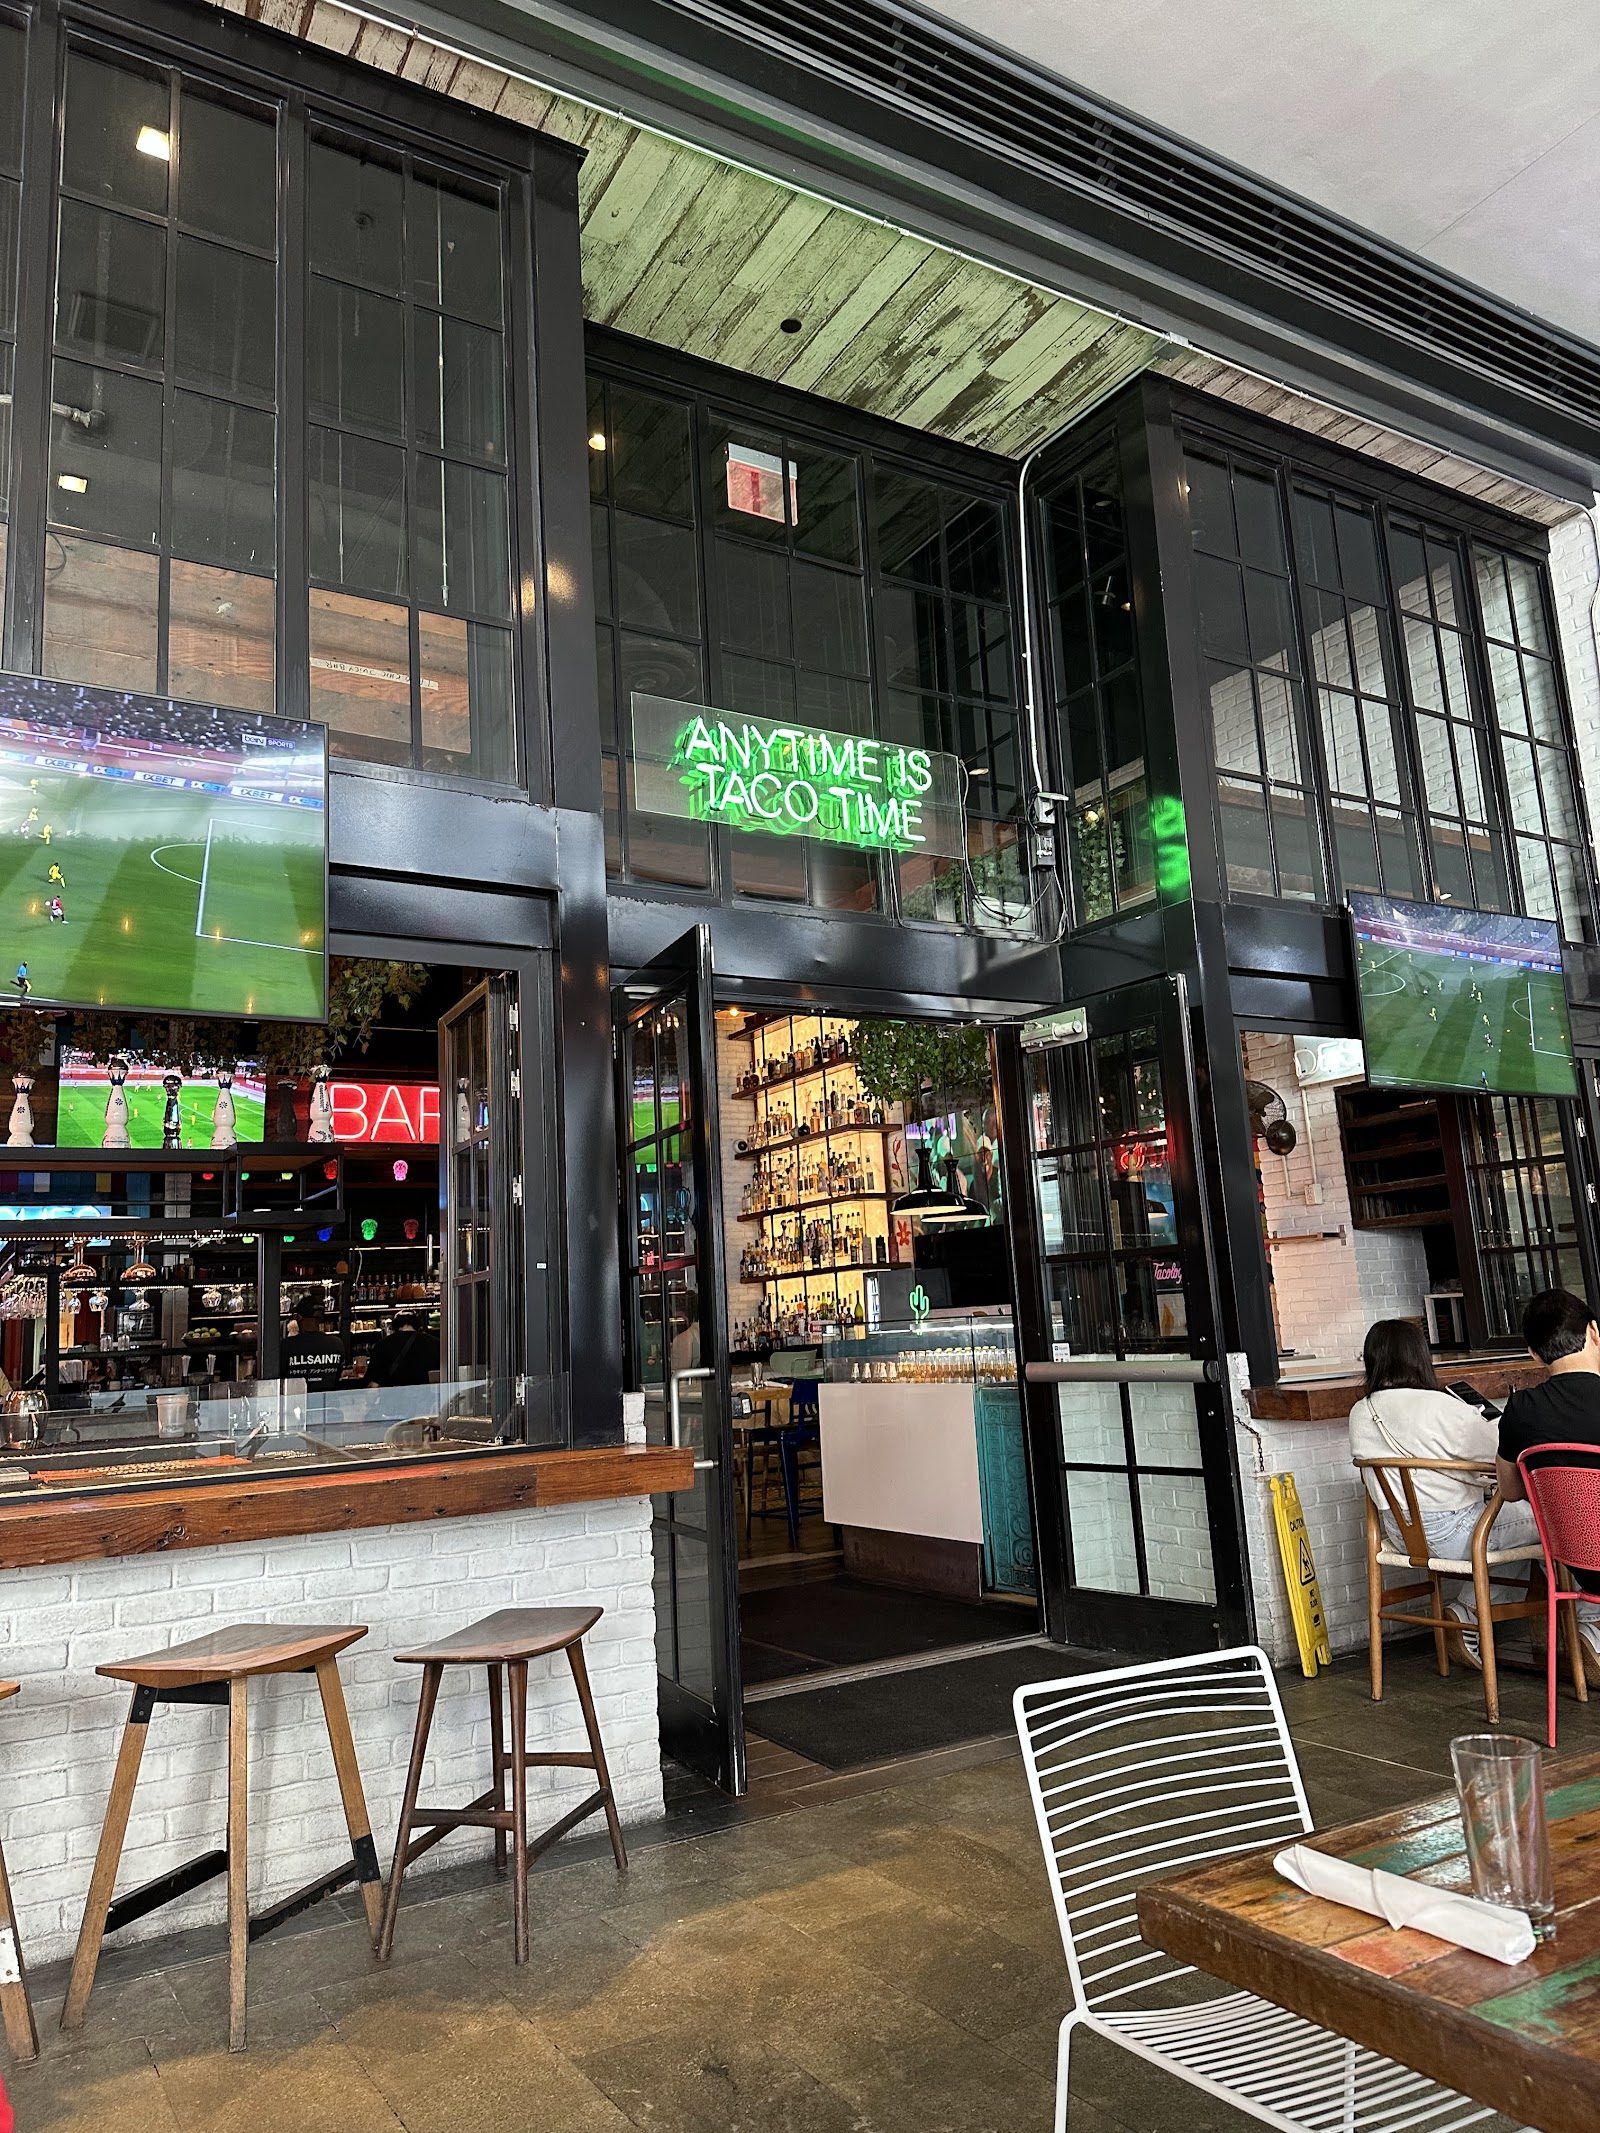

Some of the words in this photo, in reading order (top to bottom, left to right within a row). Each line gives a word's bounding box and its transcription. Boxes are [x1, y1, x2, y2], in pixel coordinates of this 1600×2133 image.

[267, 740, 294, 749] SPORTS
[684, 715, 883, 783] ANYTIME
[898, 747, 933, 792] IS
[696, 763, 819, 822] TACO
[828, 787, 927, 842] TIME
